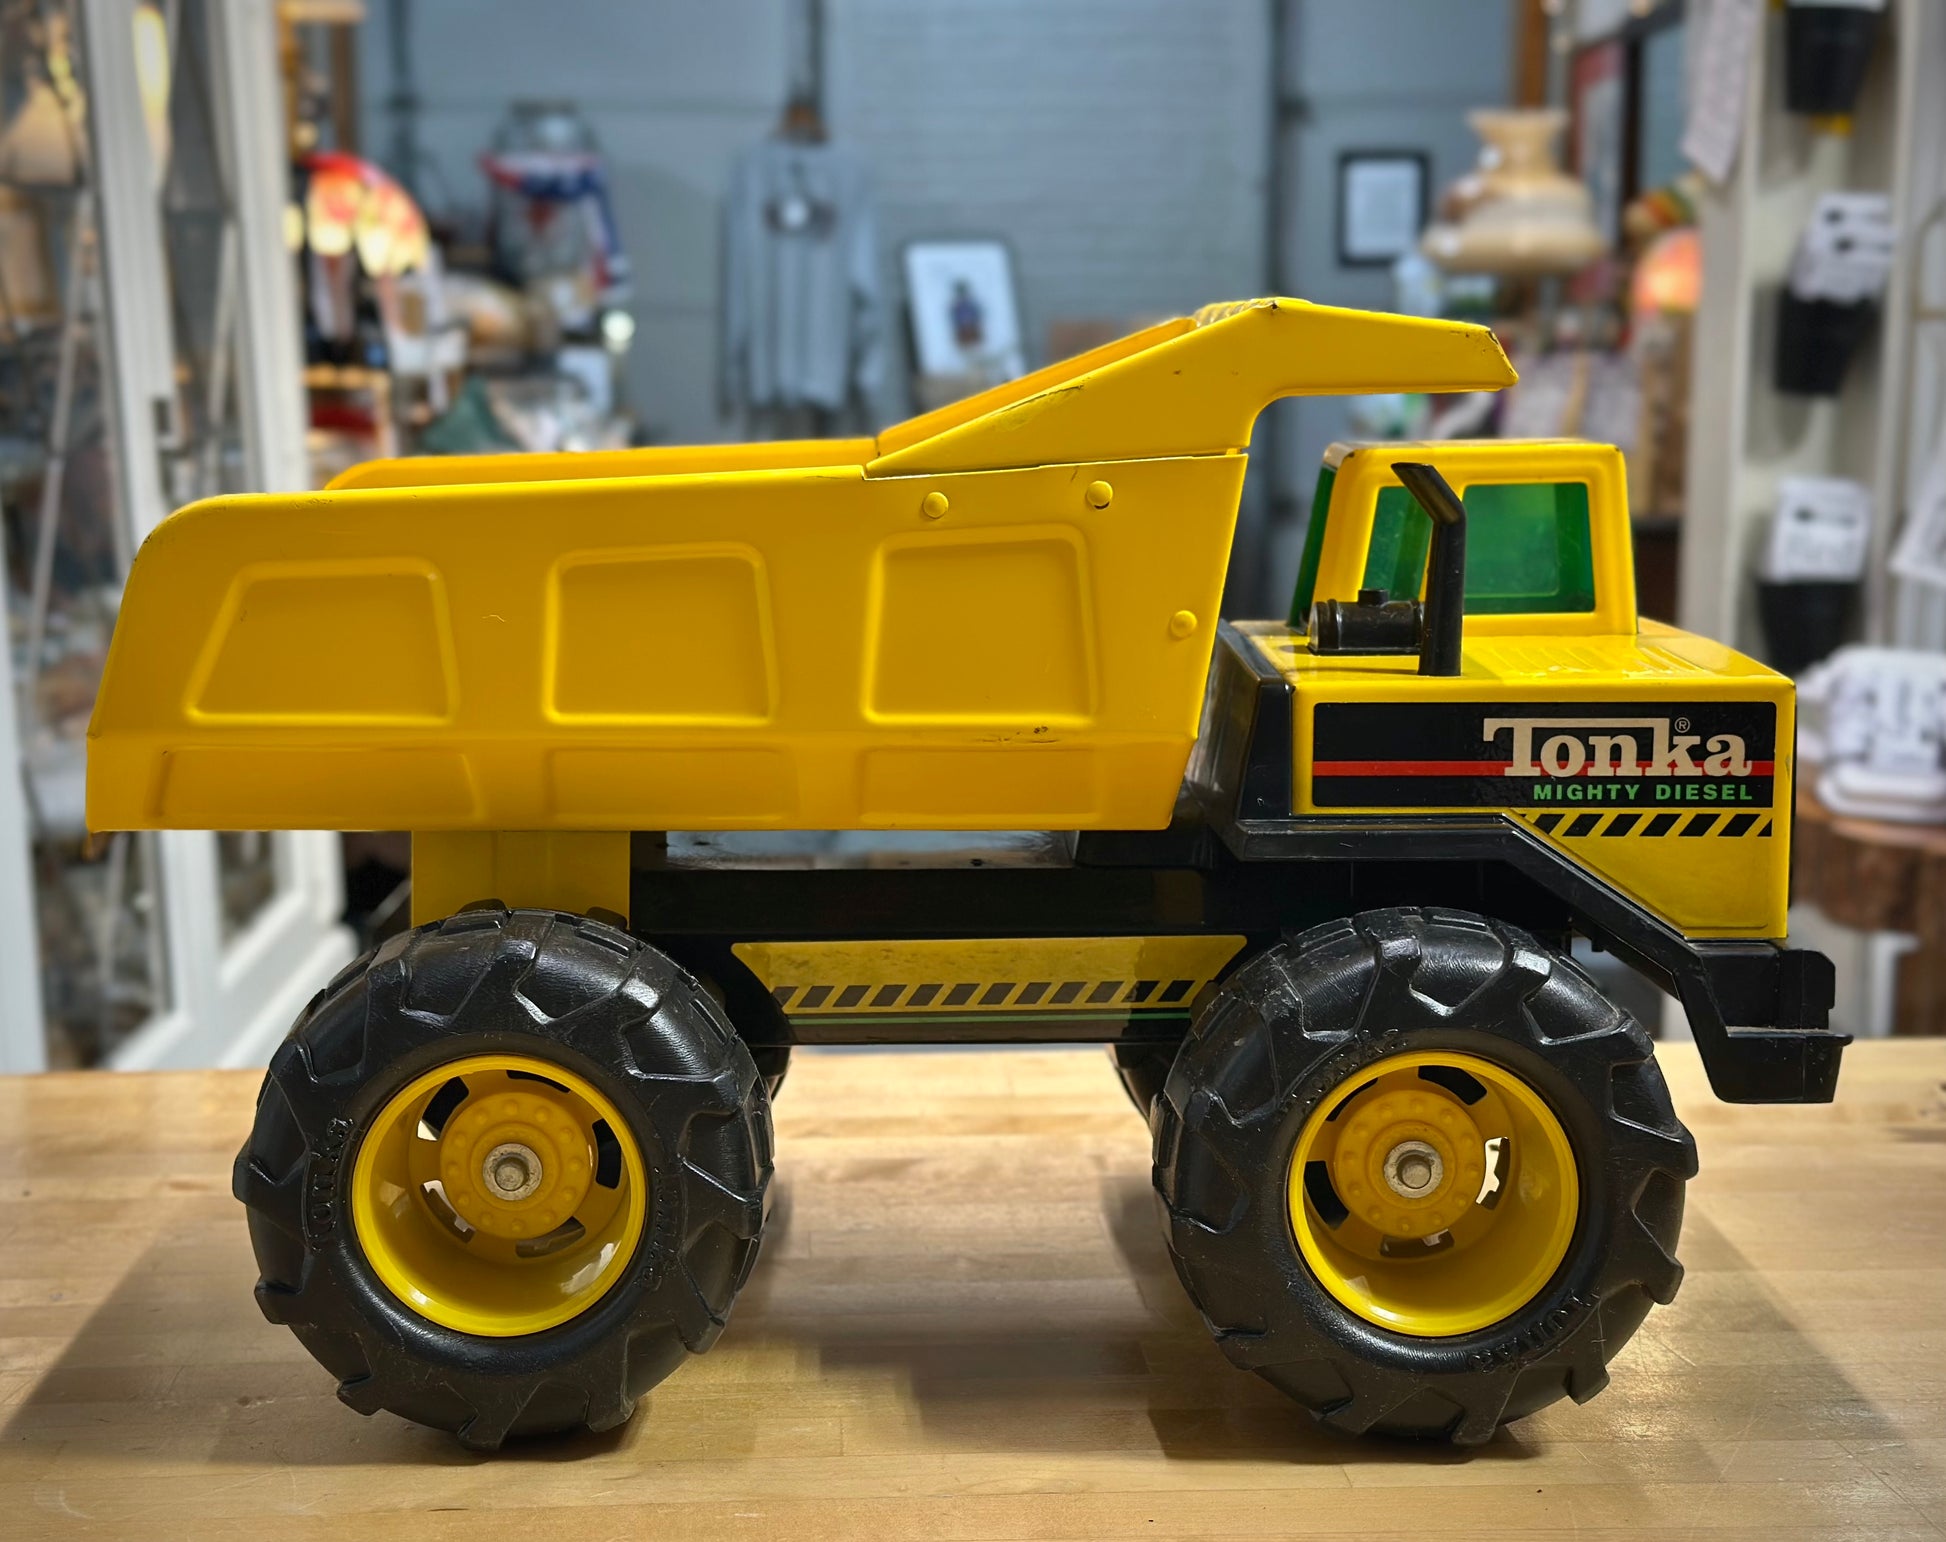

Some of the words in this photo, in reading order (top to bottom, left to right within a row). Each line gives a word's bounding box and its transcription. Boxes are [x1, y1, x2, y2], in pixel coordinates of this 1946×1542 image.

[1483, 718, 1752, 777] Tonka
[1533, 784, 1640, 800] MIGHTY
[1656, 784, 1753, 800] DIESEL
